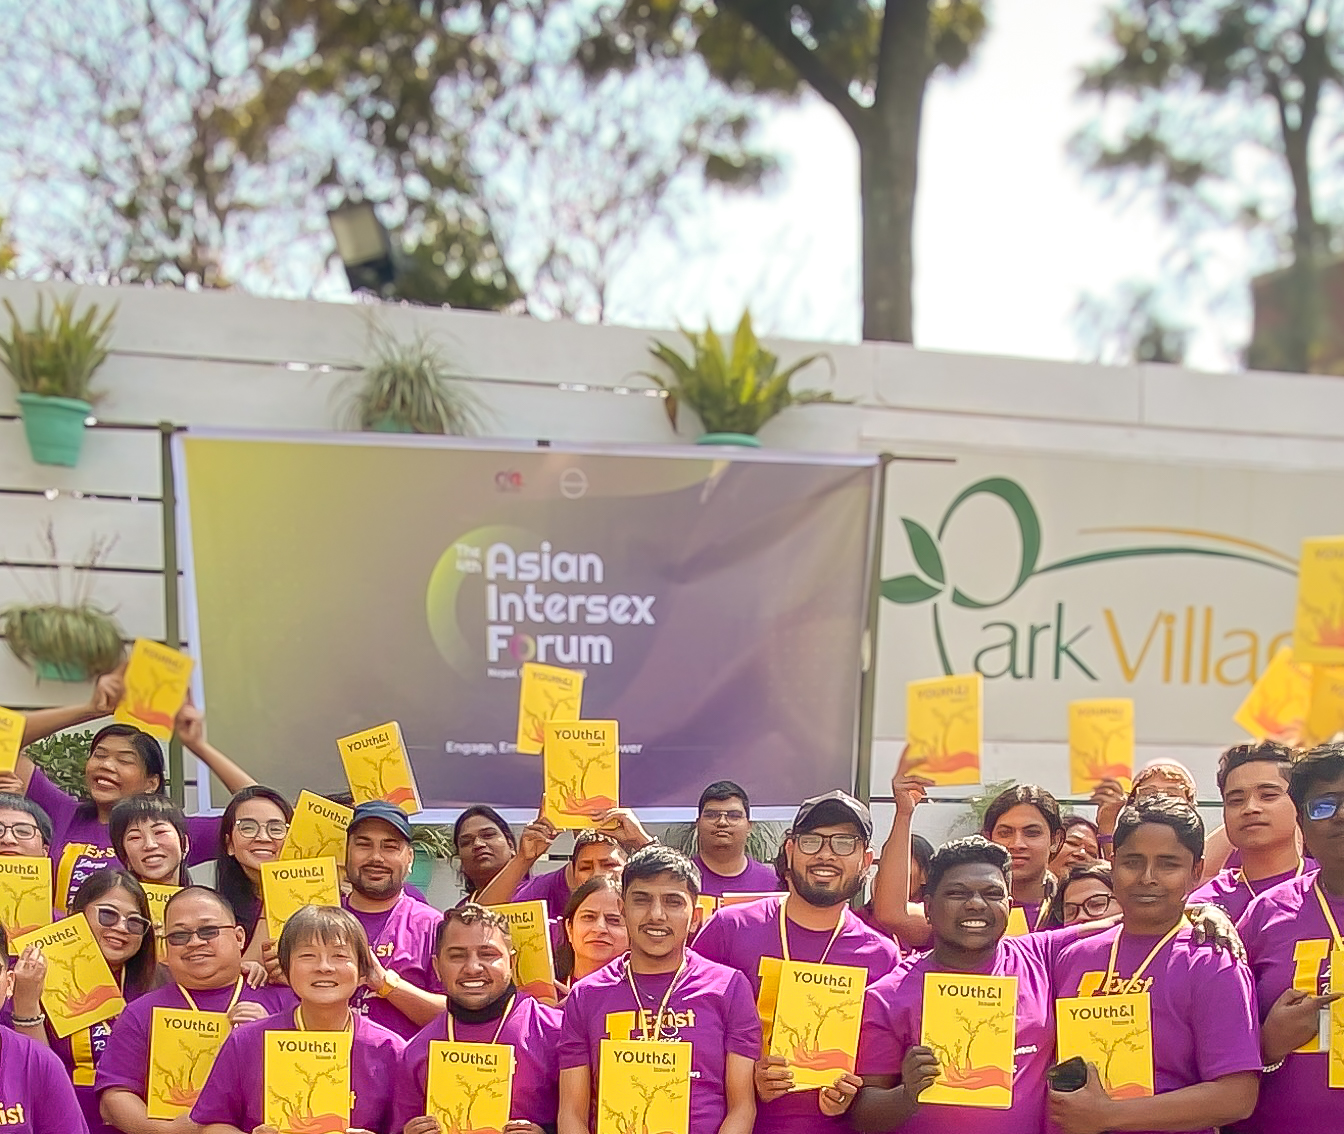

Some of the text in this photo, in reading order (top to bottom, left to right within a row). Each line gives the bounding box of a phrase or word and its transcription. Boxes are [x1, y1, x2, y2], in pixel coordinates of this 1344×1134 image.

[486, 540, 604, 583] Asian
[486, 583, 656, 625] Intersex
[487, 624, 613, 665] Forum
[347, 731, 390, 753] YOUth&I
[555, 729, 606, 740] YOUth&I
[307, 800, 349, 826] YOUth&
[272, 866, 325, 881] YOUth&I
[793, 971, 852, 988] YOUth&I
[938, 983, 1002, 1000] YOUth&I
[1069, 1005, 1135, 1021] YOUth&I
[164, 1018, 220, 1033] YOUth&I
[278, 1040, 337, 1053] YOUth&I
[441, 1050, 498, 1066] YOUth&I
[613, 1050, 677, 1066] YOUth&I
